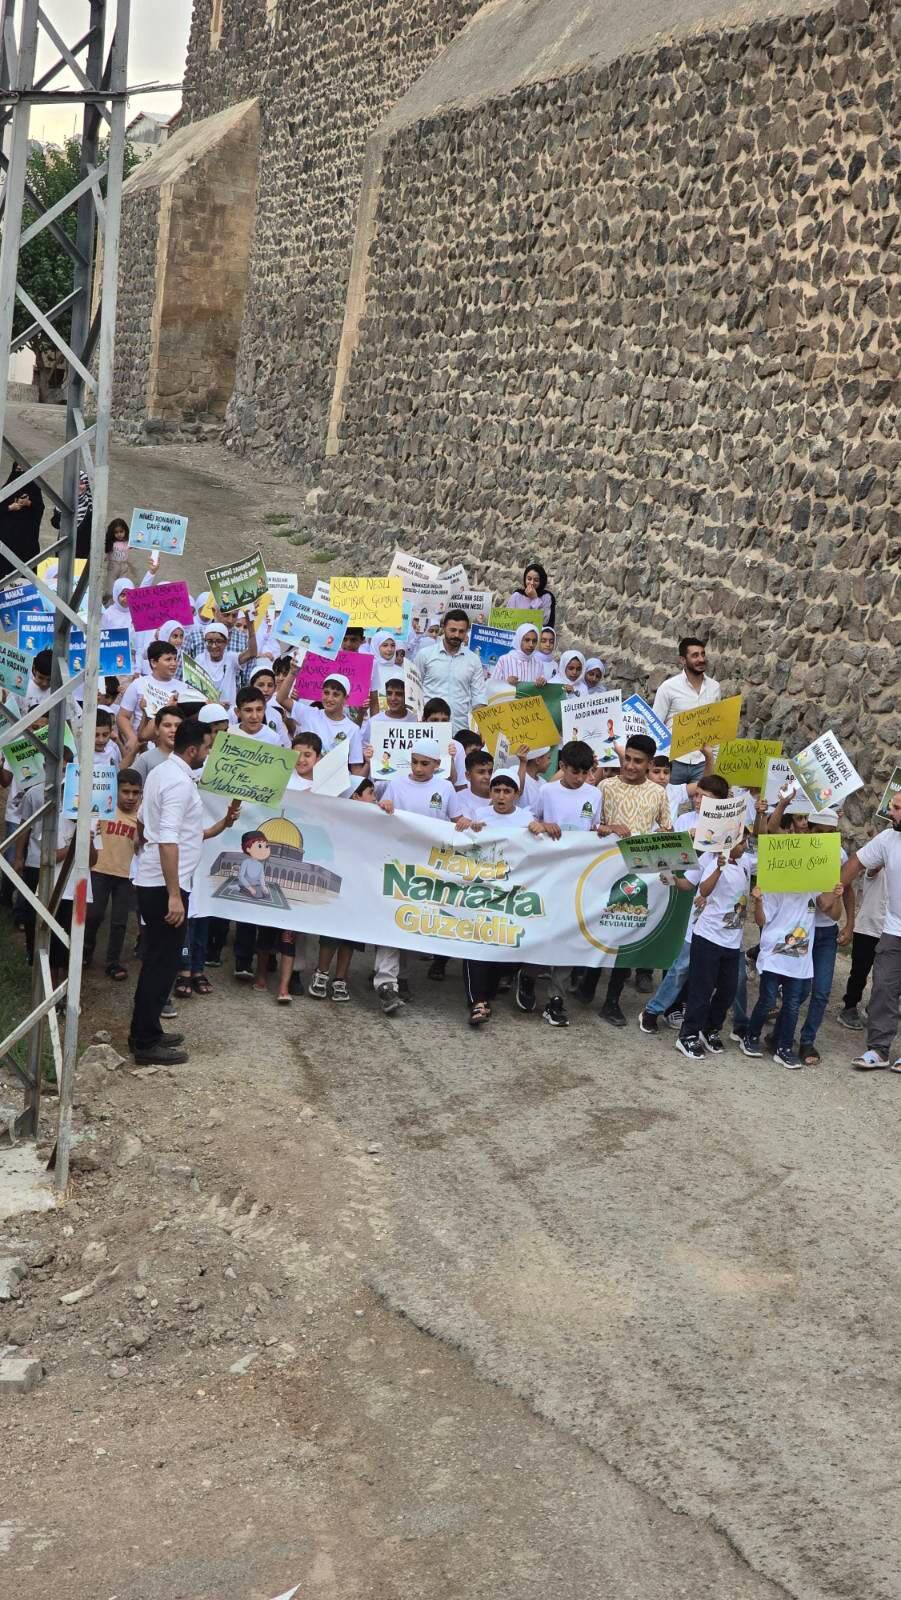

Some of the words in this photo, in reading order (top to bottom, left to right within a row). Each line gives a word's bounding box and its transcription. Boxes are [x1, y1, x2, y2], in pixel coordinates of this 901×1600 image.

[590, 707, 608, 716] NAMAZ
[388, 727, 405, 739] KIL
[408, 726, 434, 739] BENİ
[383, 739, 397, 749] EY
[427, 845, 510, 882] Hayat
[382, 863, 544, 918] Namazla
[600, 913, 647, 921] PEYGAMBER
[394, 903, 524, 947] Güzeldir
